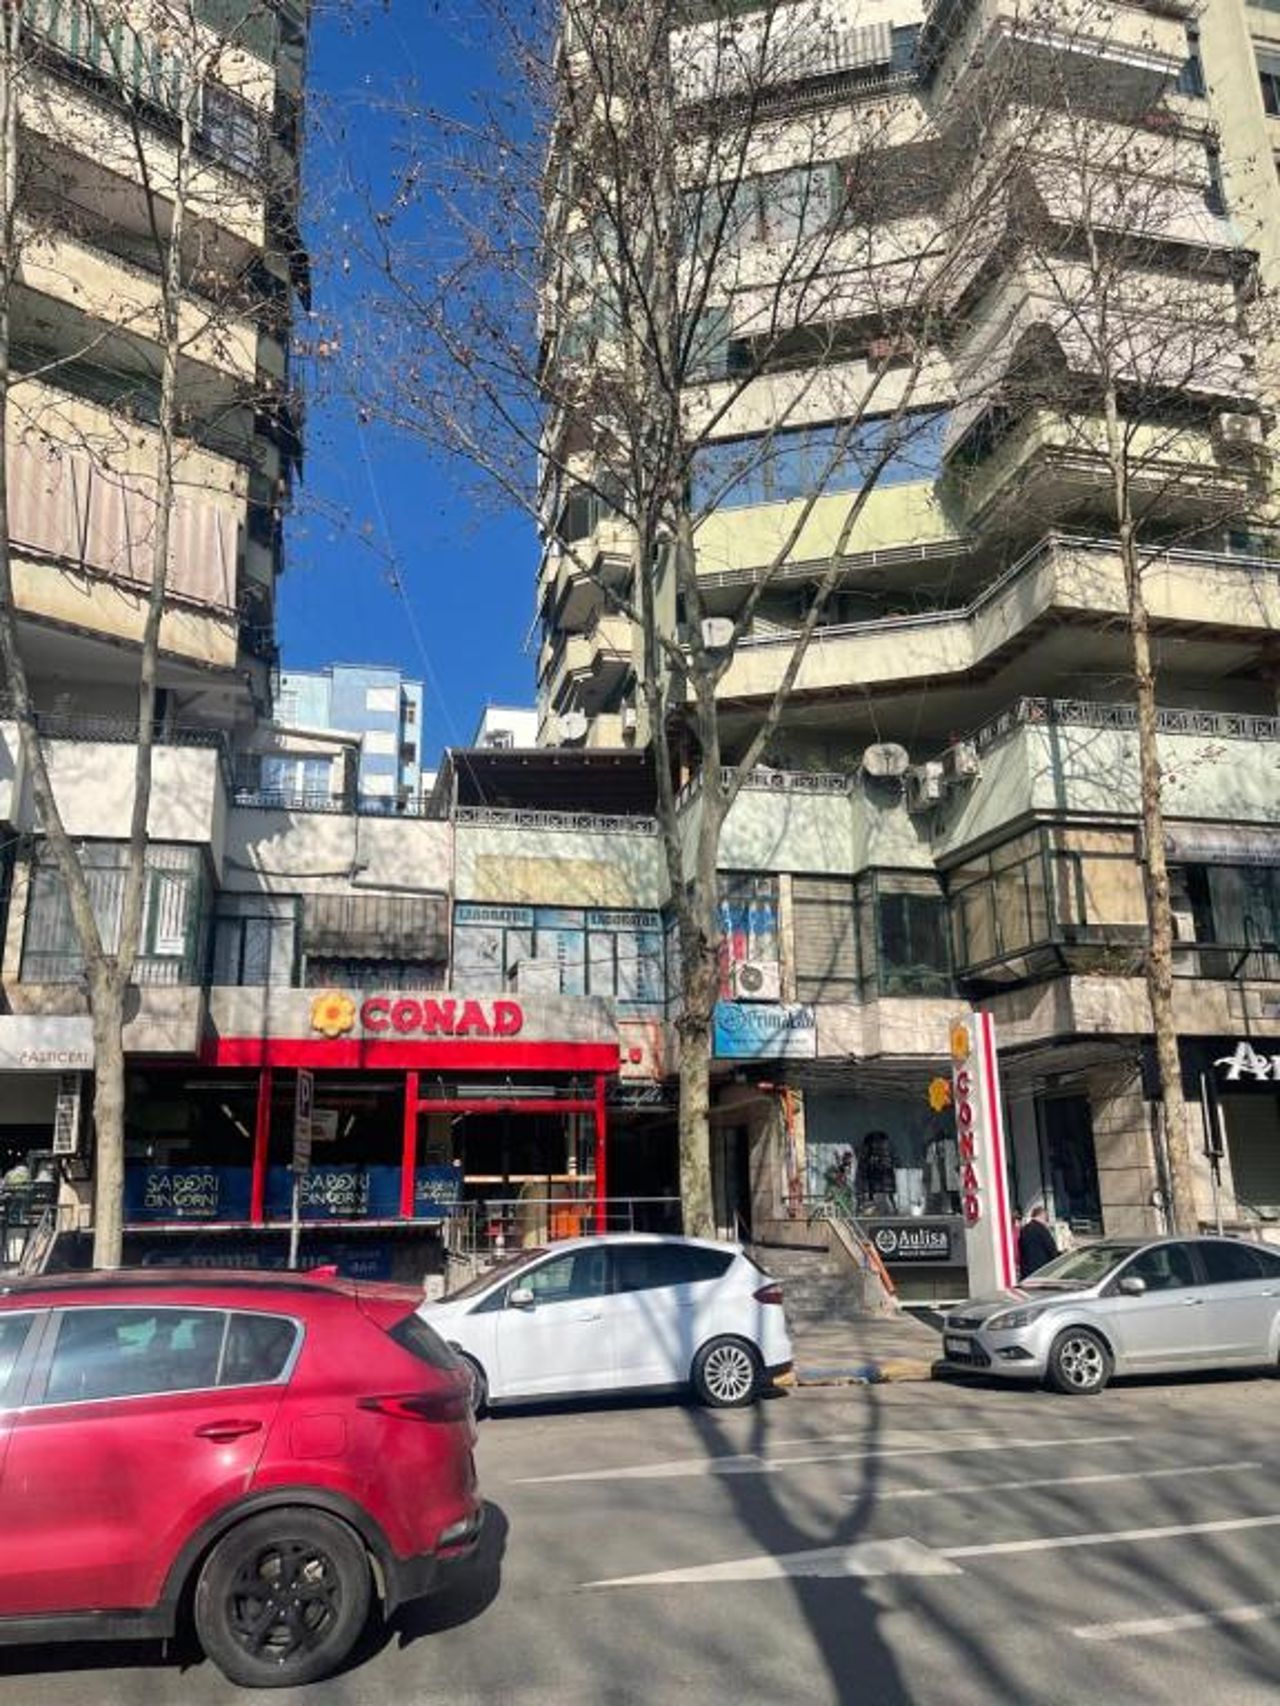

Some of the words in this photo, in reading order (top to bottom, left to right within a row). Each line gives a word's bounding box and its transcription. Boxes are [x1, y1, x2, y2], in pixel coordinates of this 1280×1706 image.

[360, 997, 524, 1036] CONAD
[956, 1069, 980, 1223] CONAD
[900, 1229, 947, 1244] Aulisa
